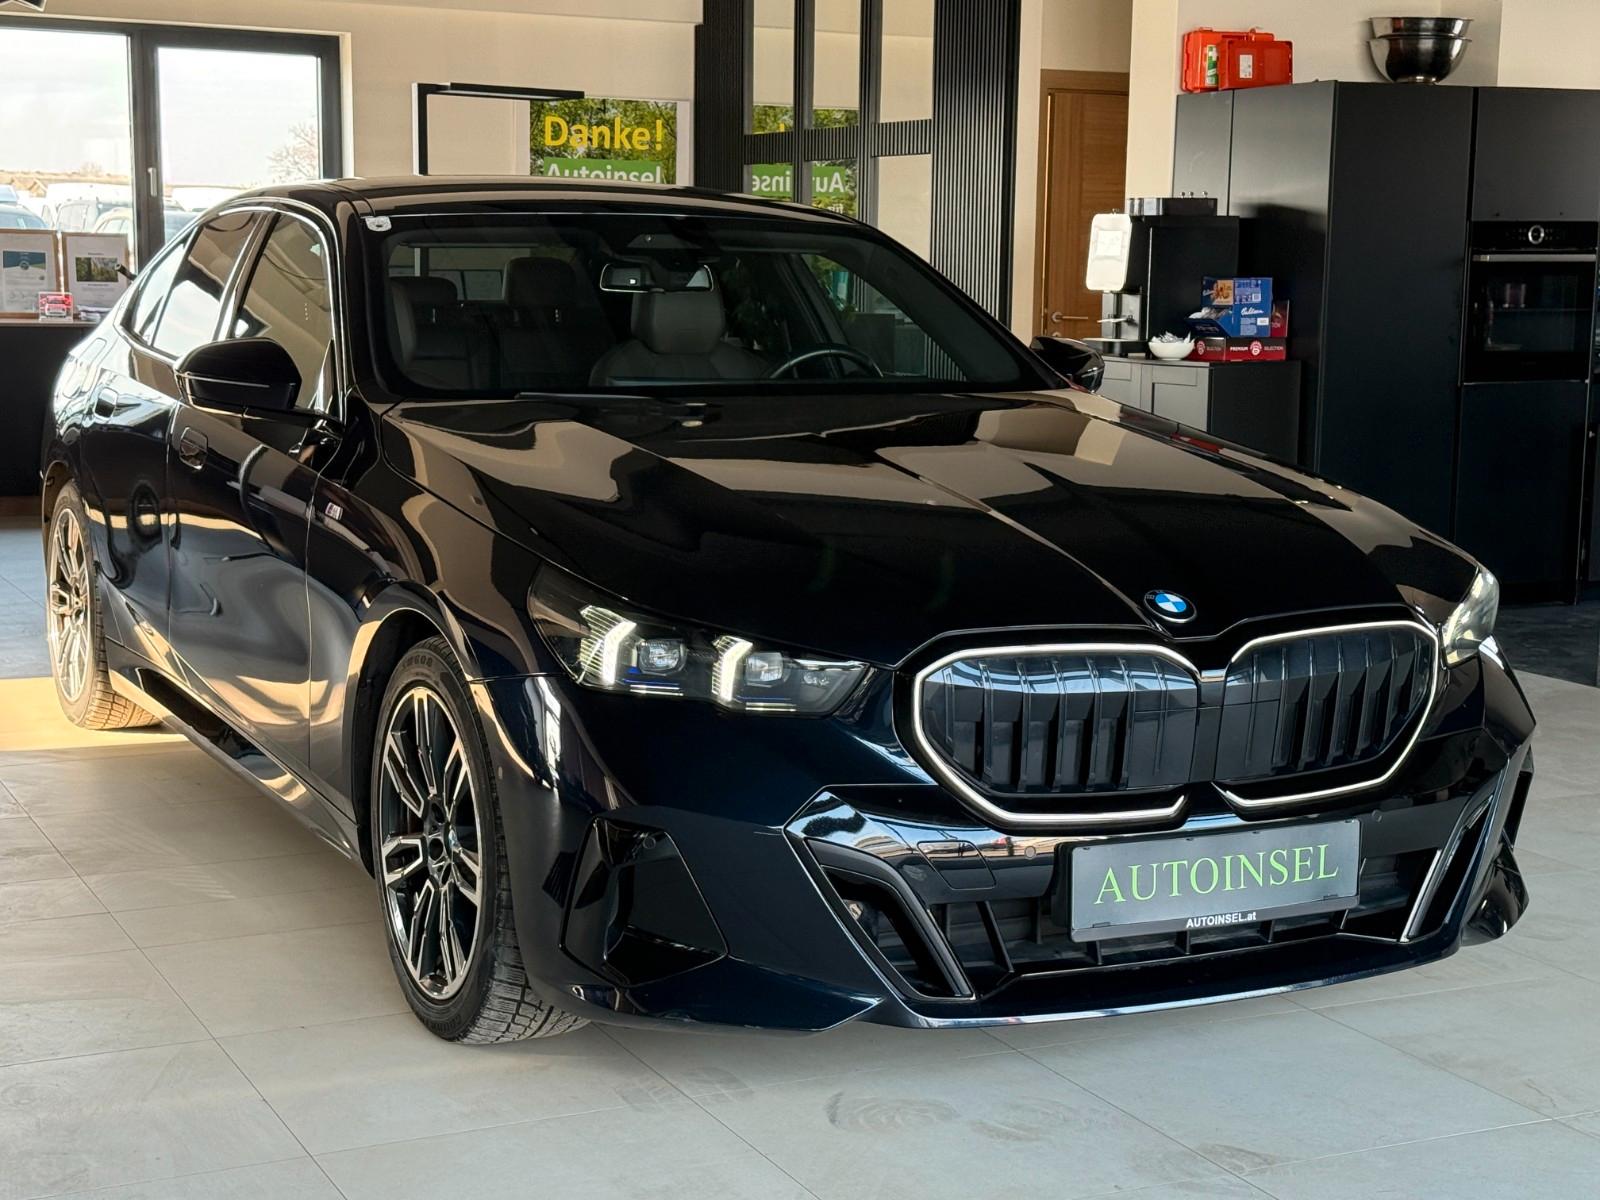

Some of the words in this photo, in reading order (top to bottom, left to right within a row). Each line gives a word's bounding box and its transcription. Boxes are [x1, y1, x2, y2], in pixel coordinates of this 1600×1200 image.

[544, 115, 663, 151] Danke!
[1093, 844, 1339, 905] AUTOINSEL
[1186, 911, 1257, 929] AUTOINSEL.at
